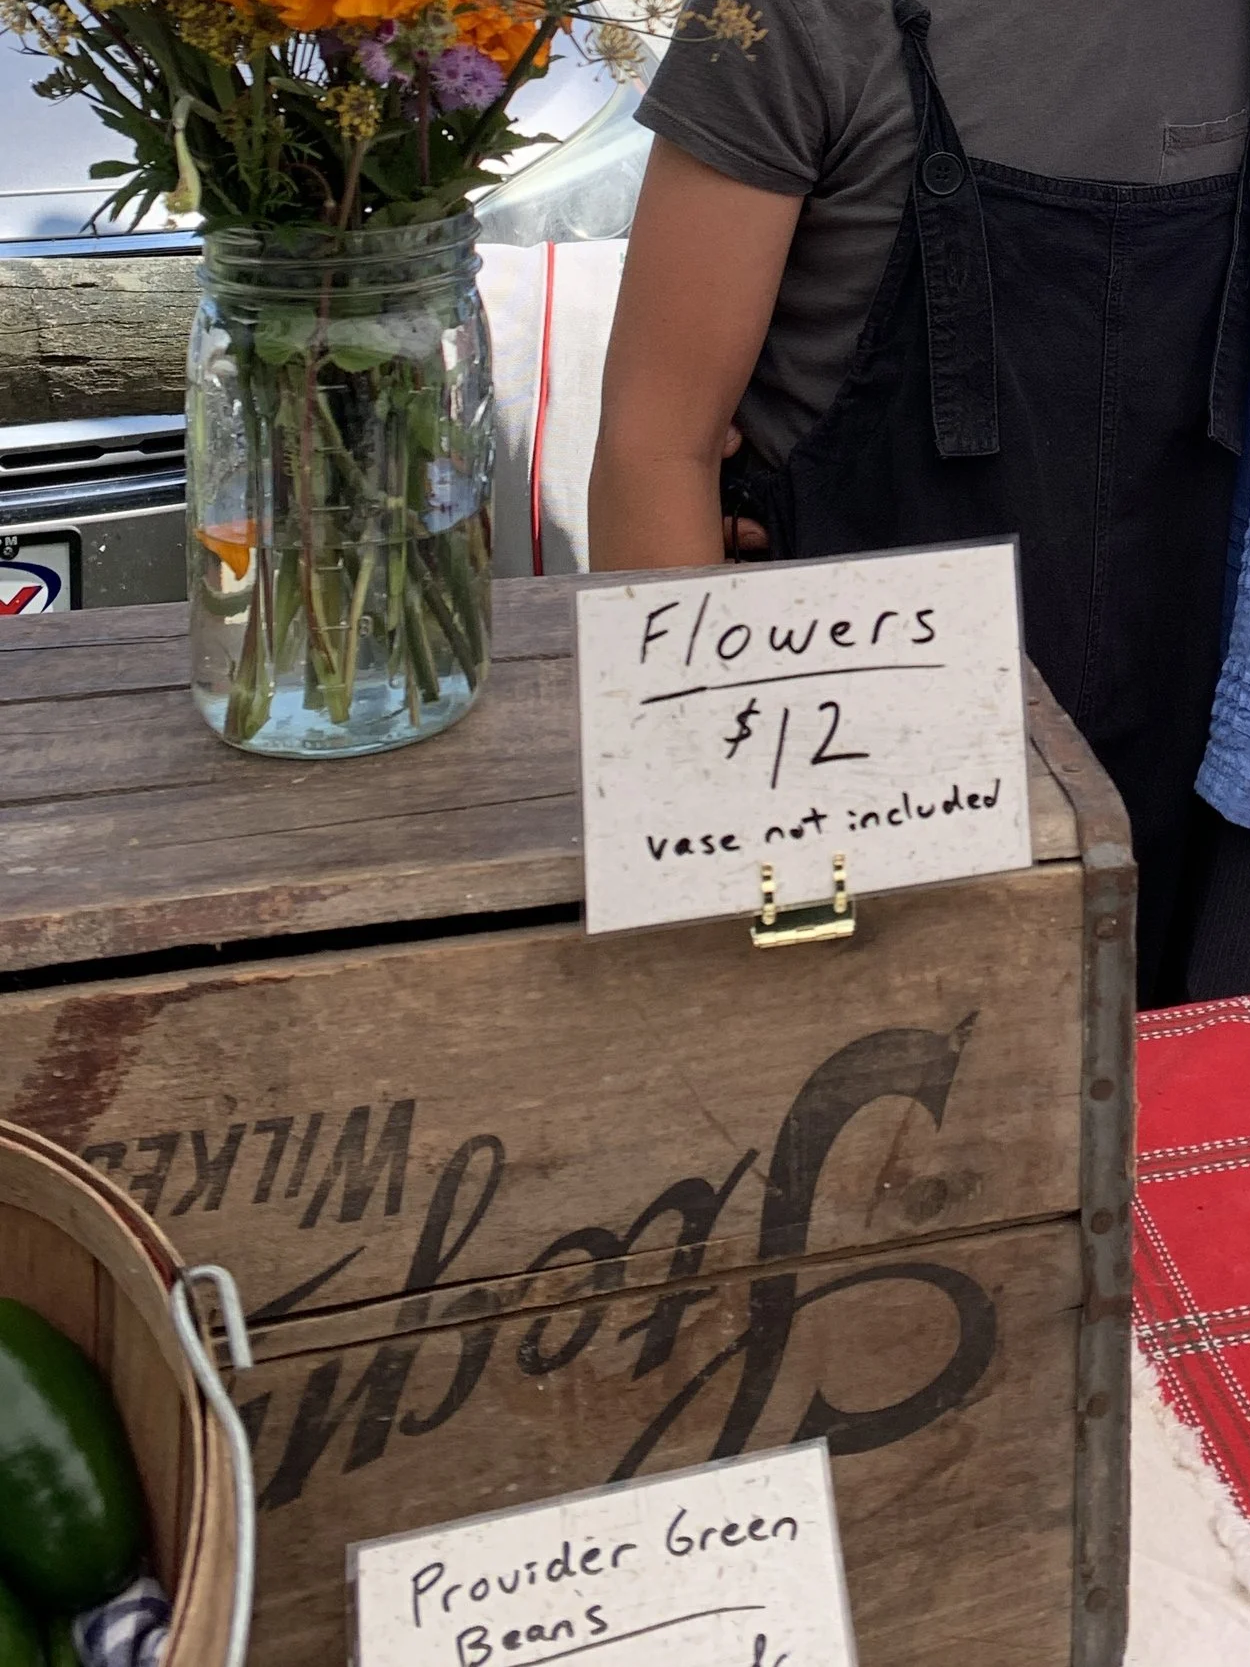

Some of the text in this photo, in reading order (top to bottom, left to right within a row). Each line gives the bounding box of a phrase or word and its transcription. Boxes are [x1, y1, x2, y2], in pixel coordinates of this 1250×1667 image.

[640, 592, 936, 665] Flowers
[723, 698, 870, 790] $12
[764, 807, 828, 840] not
[847, 778, 1001, 831] included
[411, 1507, 798, 1628] Provider Green
[456, 1604, 609, 1667] Beans
